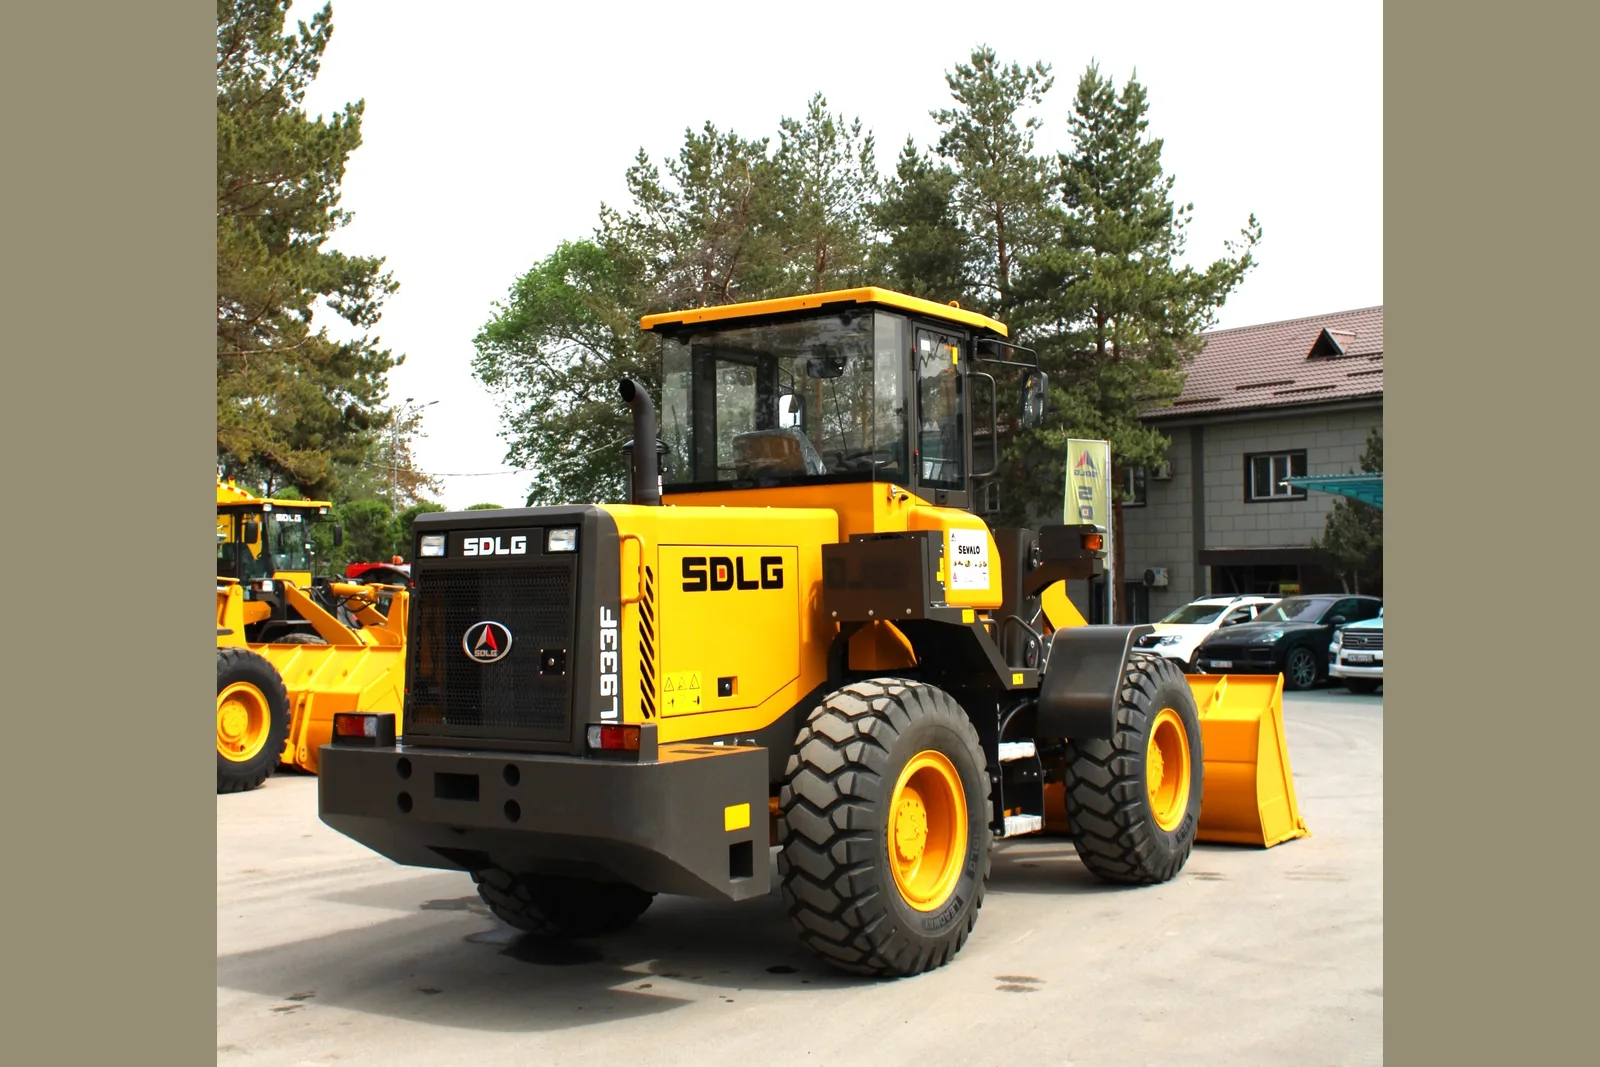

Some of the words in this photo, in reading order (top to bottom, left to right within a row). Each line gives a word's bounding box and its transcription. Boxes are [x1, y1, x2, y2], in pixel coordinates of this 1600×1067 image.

[275, 513, 302, 523] SDLG
[463, 536, 527, 557] SDLG
[682, 556, 784, 592] SDLG
